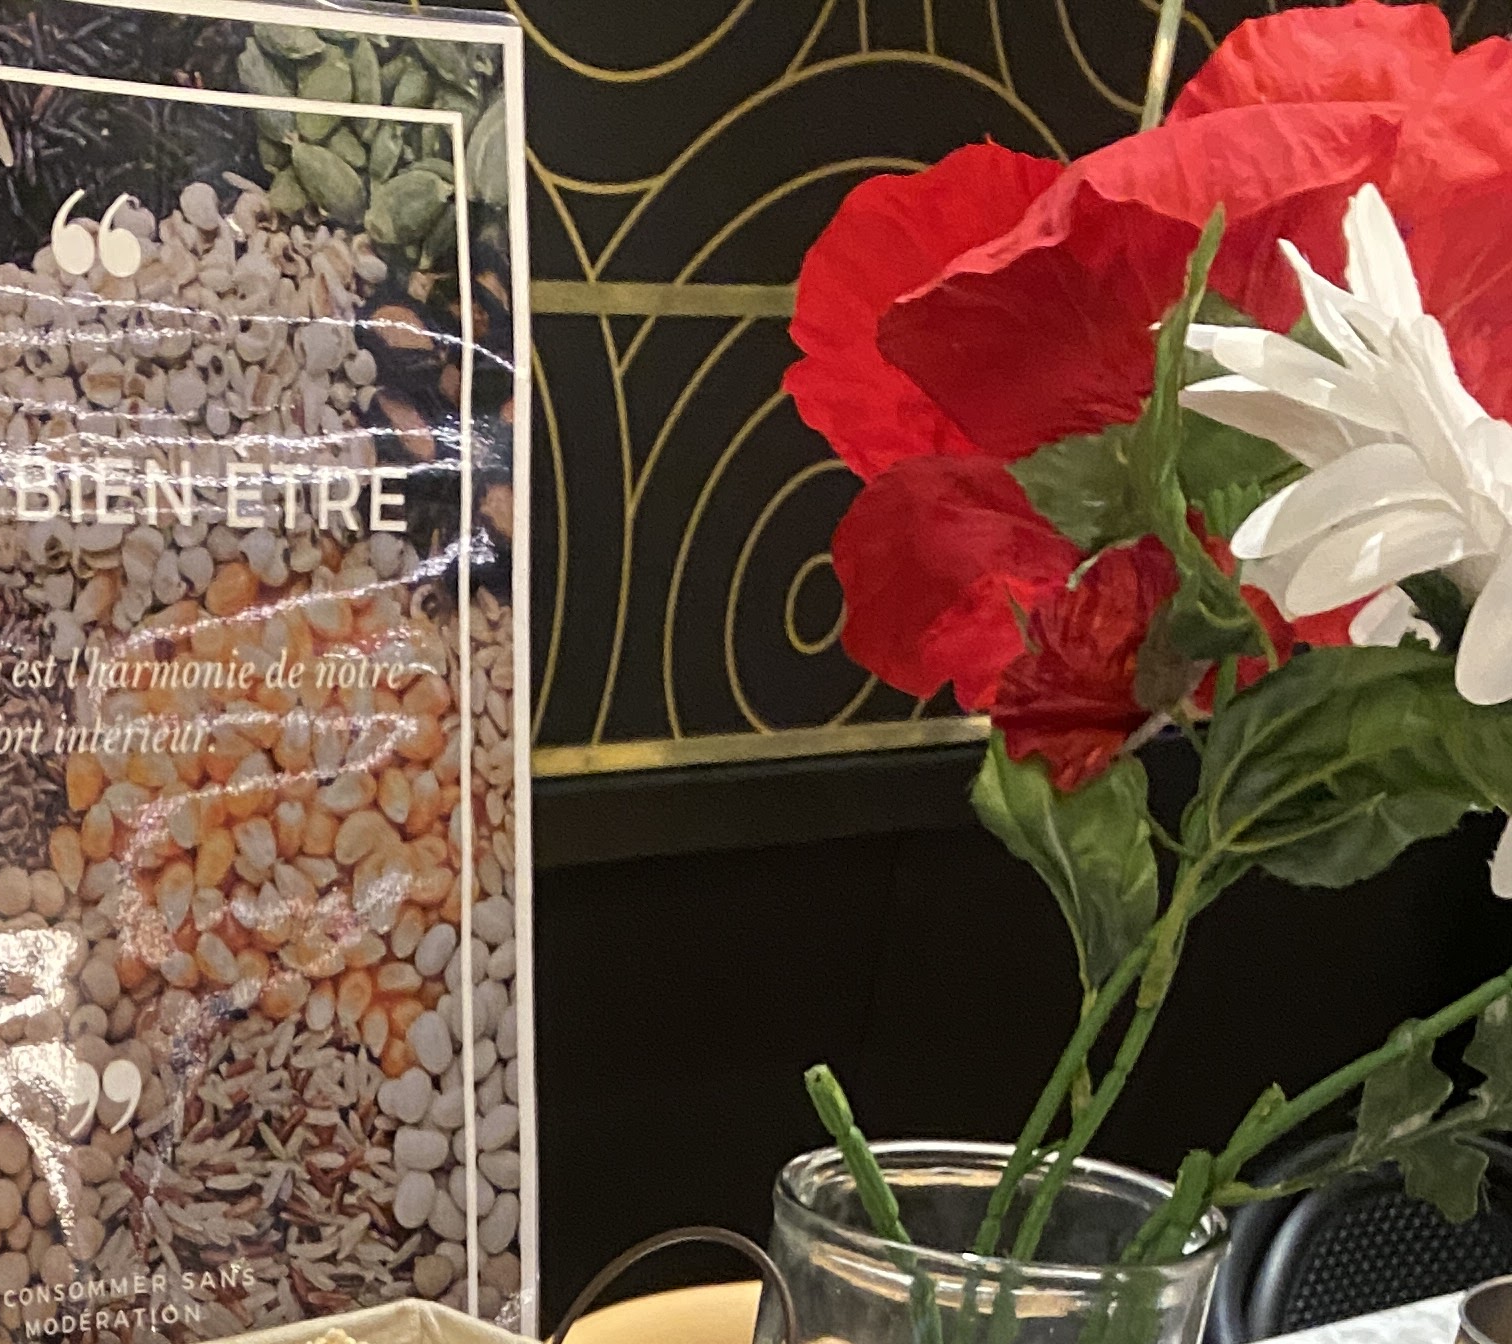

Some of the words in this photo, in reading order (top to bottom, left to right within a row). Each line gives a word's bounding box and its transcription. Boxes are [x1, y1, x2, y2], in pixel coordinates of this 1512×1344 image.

[15, 448, 193, 527] BIEN
[11, 654, 57, 689] est
[65, 645, 255, 690] l'harmonie
[264, 648, 306, 690] de
[315, 654, 406, 690] notre
[54, 714, 216, 755] intérieur.
[2, 1273, 168, 1309] CONSOMMER
[182, 1266, 257, 1292] SANS
[24, 1303, 202, 1339] MODÉRATION
